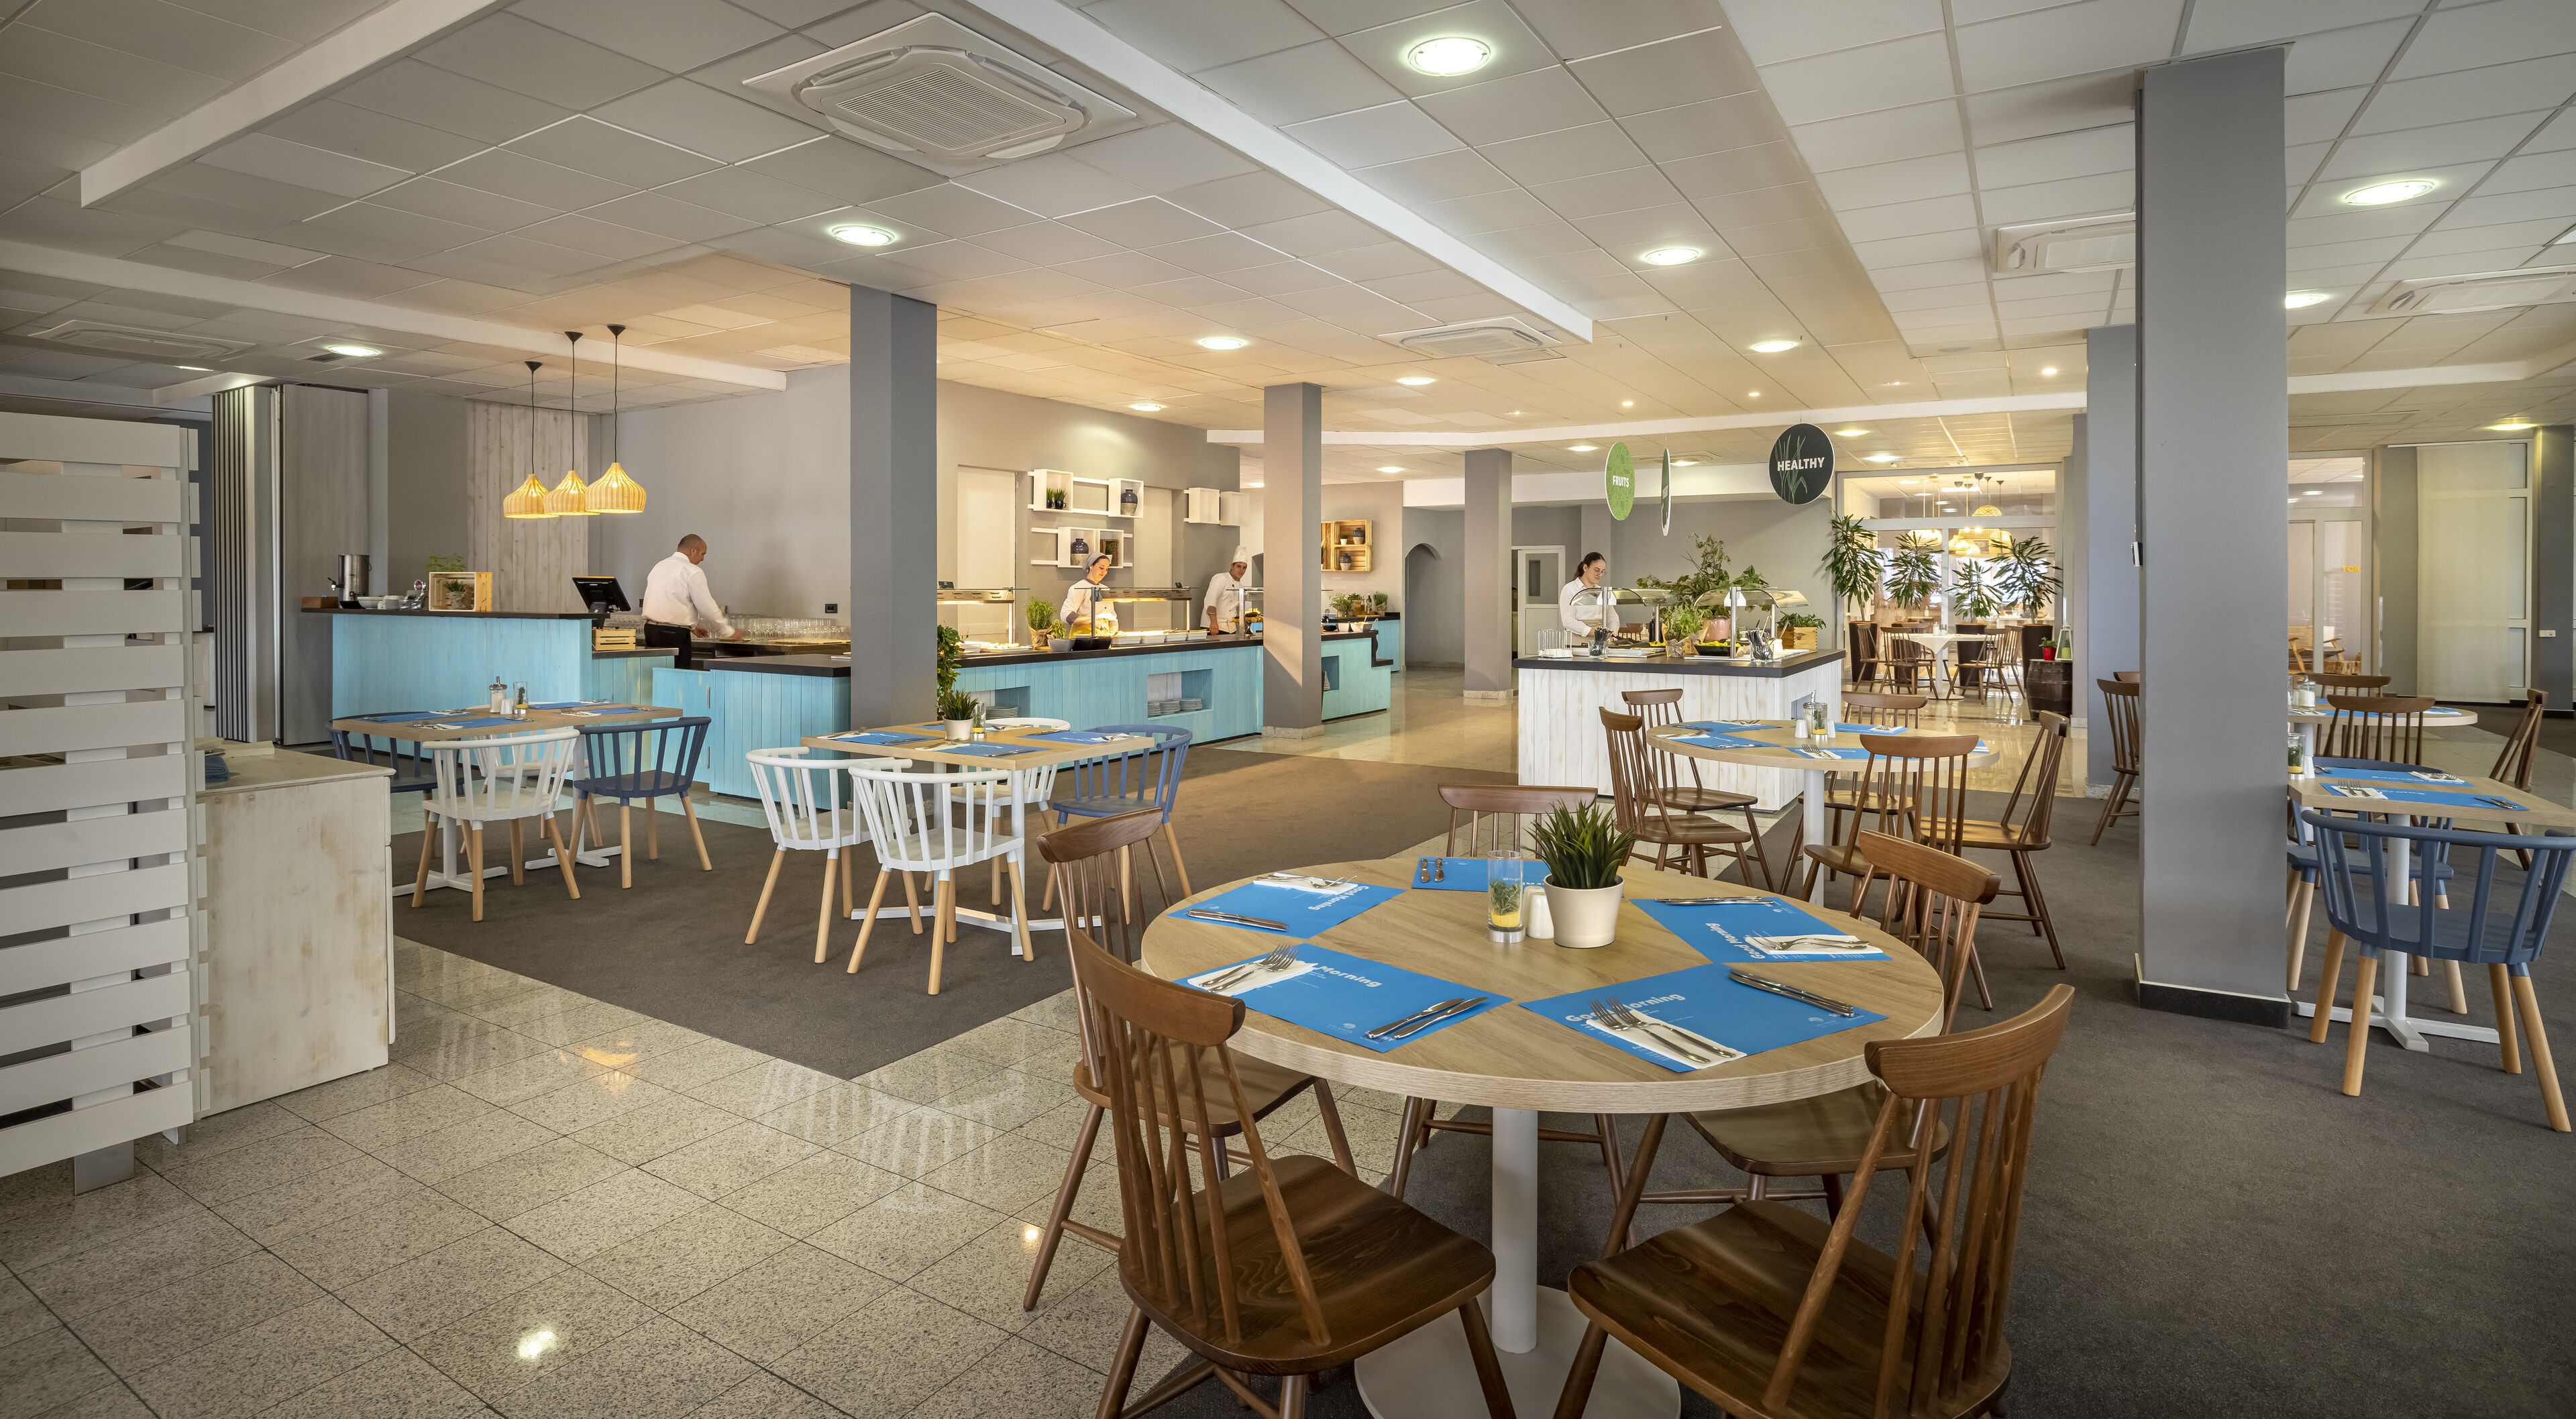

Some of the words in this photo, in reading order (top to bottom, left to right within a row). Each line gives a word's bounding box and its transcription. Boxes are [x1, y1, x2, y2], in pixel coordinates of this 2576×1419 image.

[1777, 457, 1825, 471] HEALTHY
[1613, 475, 1629, 488] FRUITS
[1705, 923, 1743, 943] Morning
[1733, 945, 1766, 959] Good
[1320, 965, 1383, 988] Morning
[1622, 994, 1686, 1010] orning
